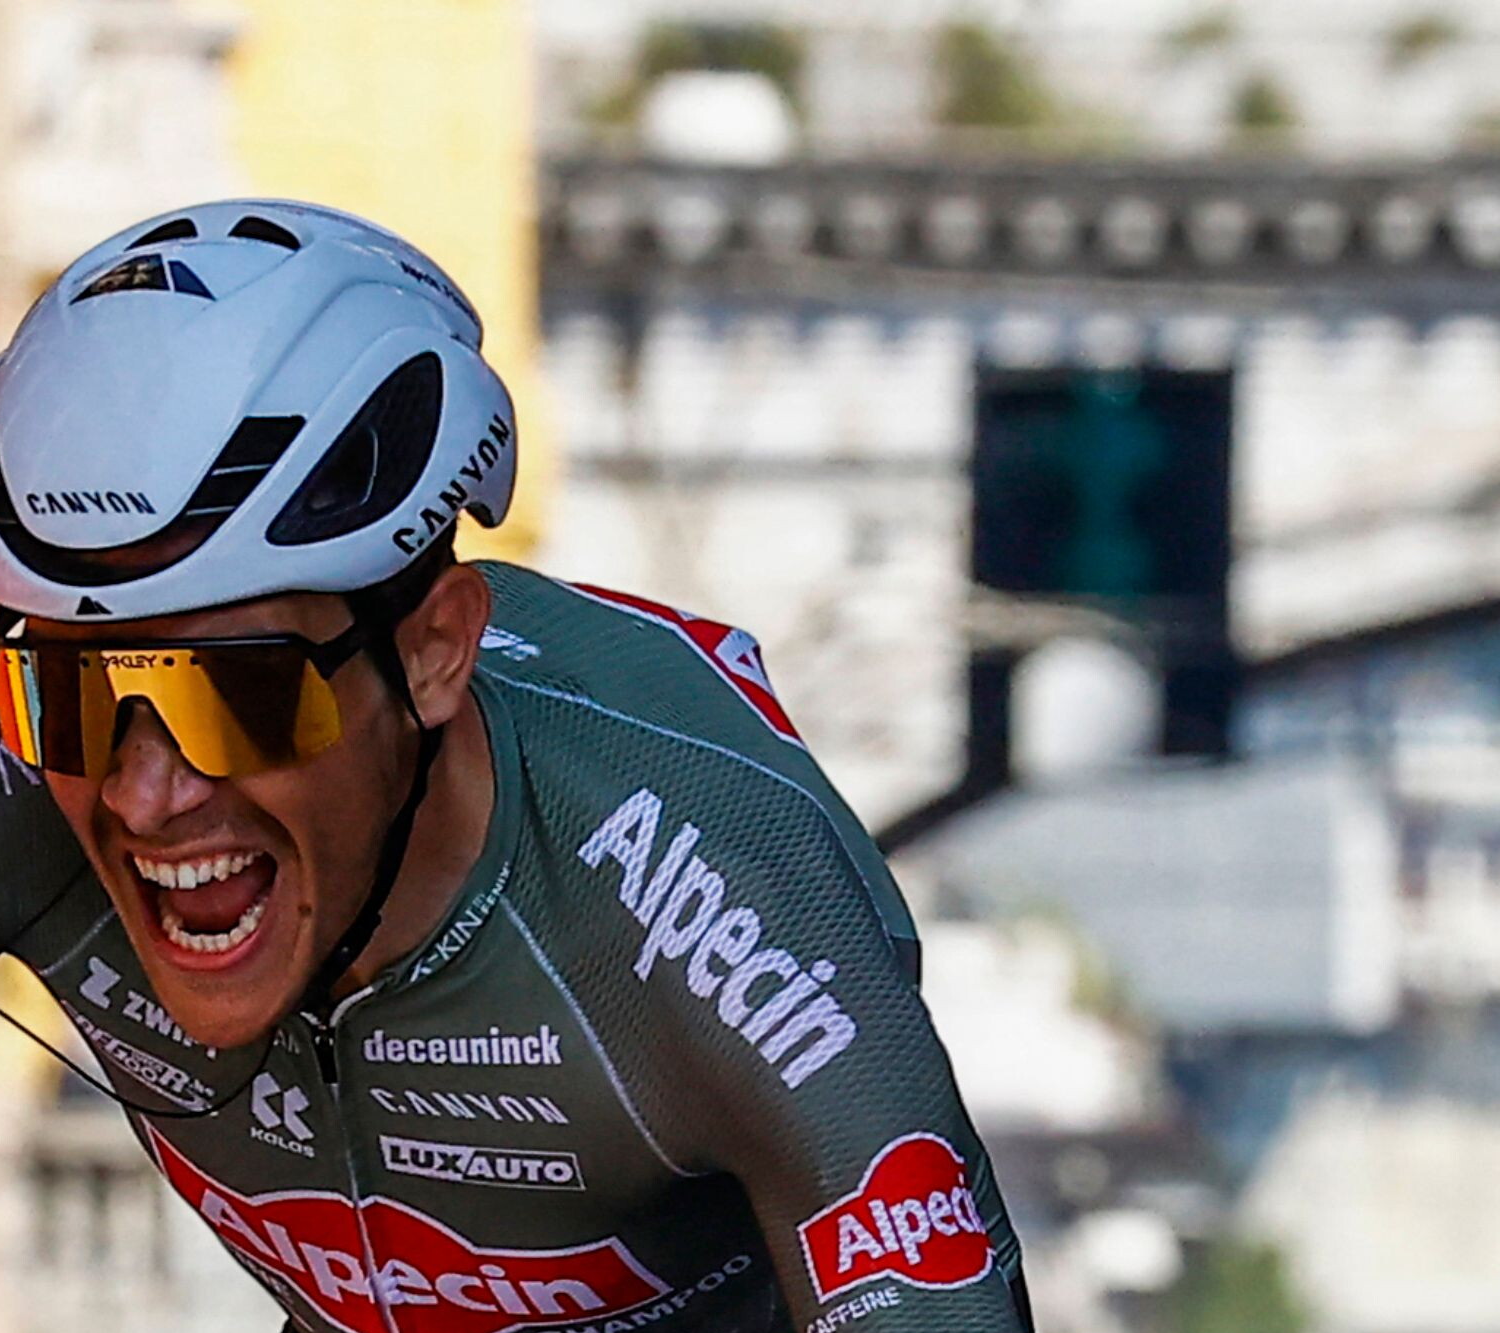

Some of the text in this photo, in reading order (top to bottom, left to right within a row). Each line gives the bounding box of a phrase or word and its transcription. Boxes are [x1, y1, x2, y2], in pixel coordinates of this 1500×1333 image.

[26, 491, 156, 516] CANYON
[391, 414, 511, 557] CANYON
[577, 788, 858, 1089] Alpecin
[362, 1026, 562, 1067] deceuninck
[369, 1086, 569, 1126] CANYON
[200, 1188, 607, 1316] Alpecin
